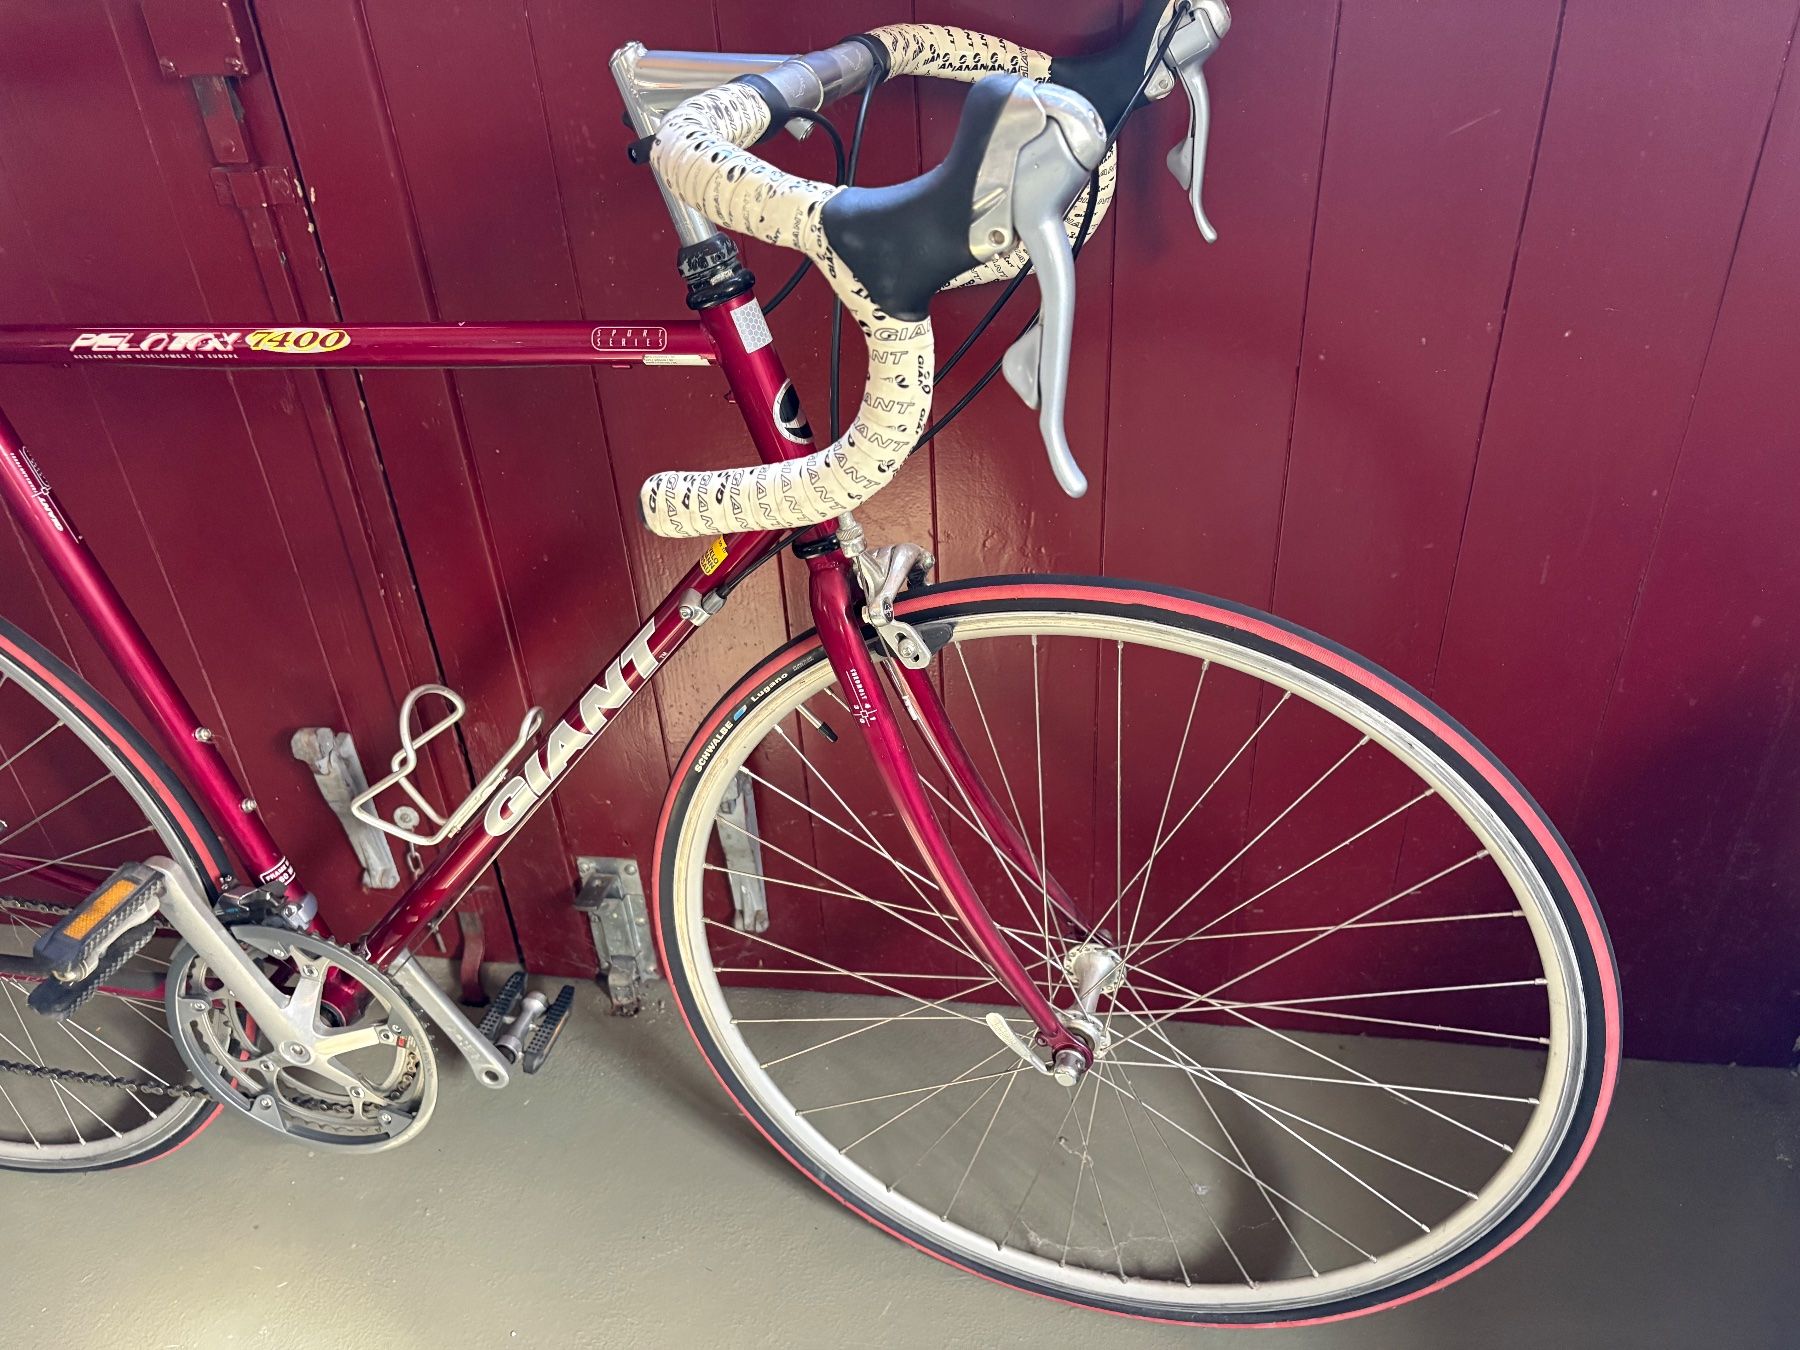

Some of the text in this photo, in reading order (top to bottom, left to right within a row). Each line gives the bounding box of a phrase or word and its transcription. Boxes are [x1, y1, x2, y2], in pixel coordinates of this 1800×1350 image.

[252, 330, 343, 349] 7400
[596, 329, 663, 337] SPORT
[596, 338, 663, 347] SERIES
[666, 473, 691, 536] GIAN
[698, 472, 723, 533] GIAN
[730, 470, 754, 530] GIAN
[484, 616, 659, 837] GIANT
[694, 672, 788, 773] SCHWALBE Lugano
